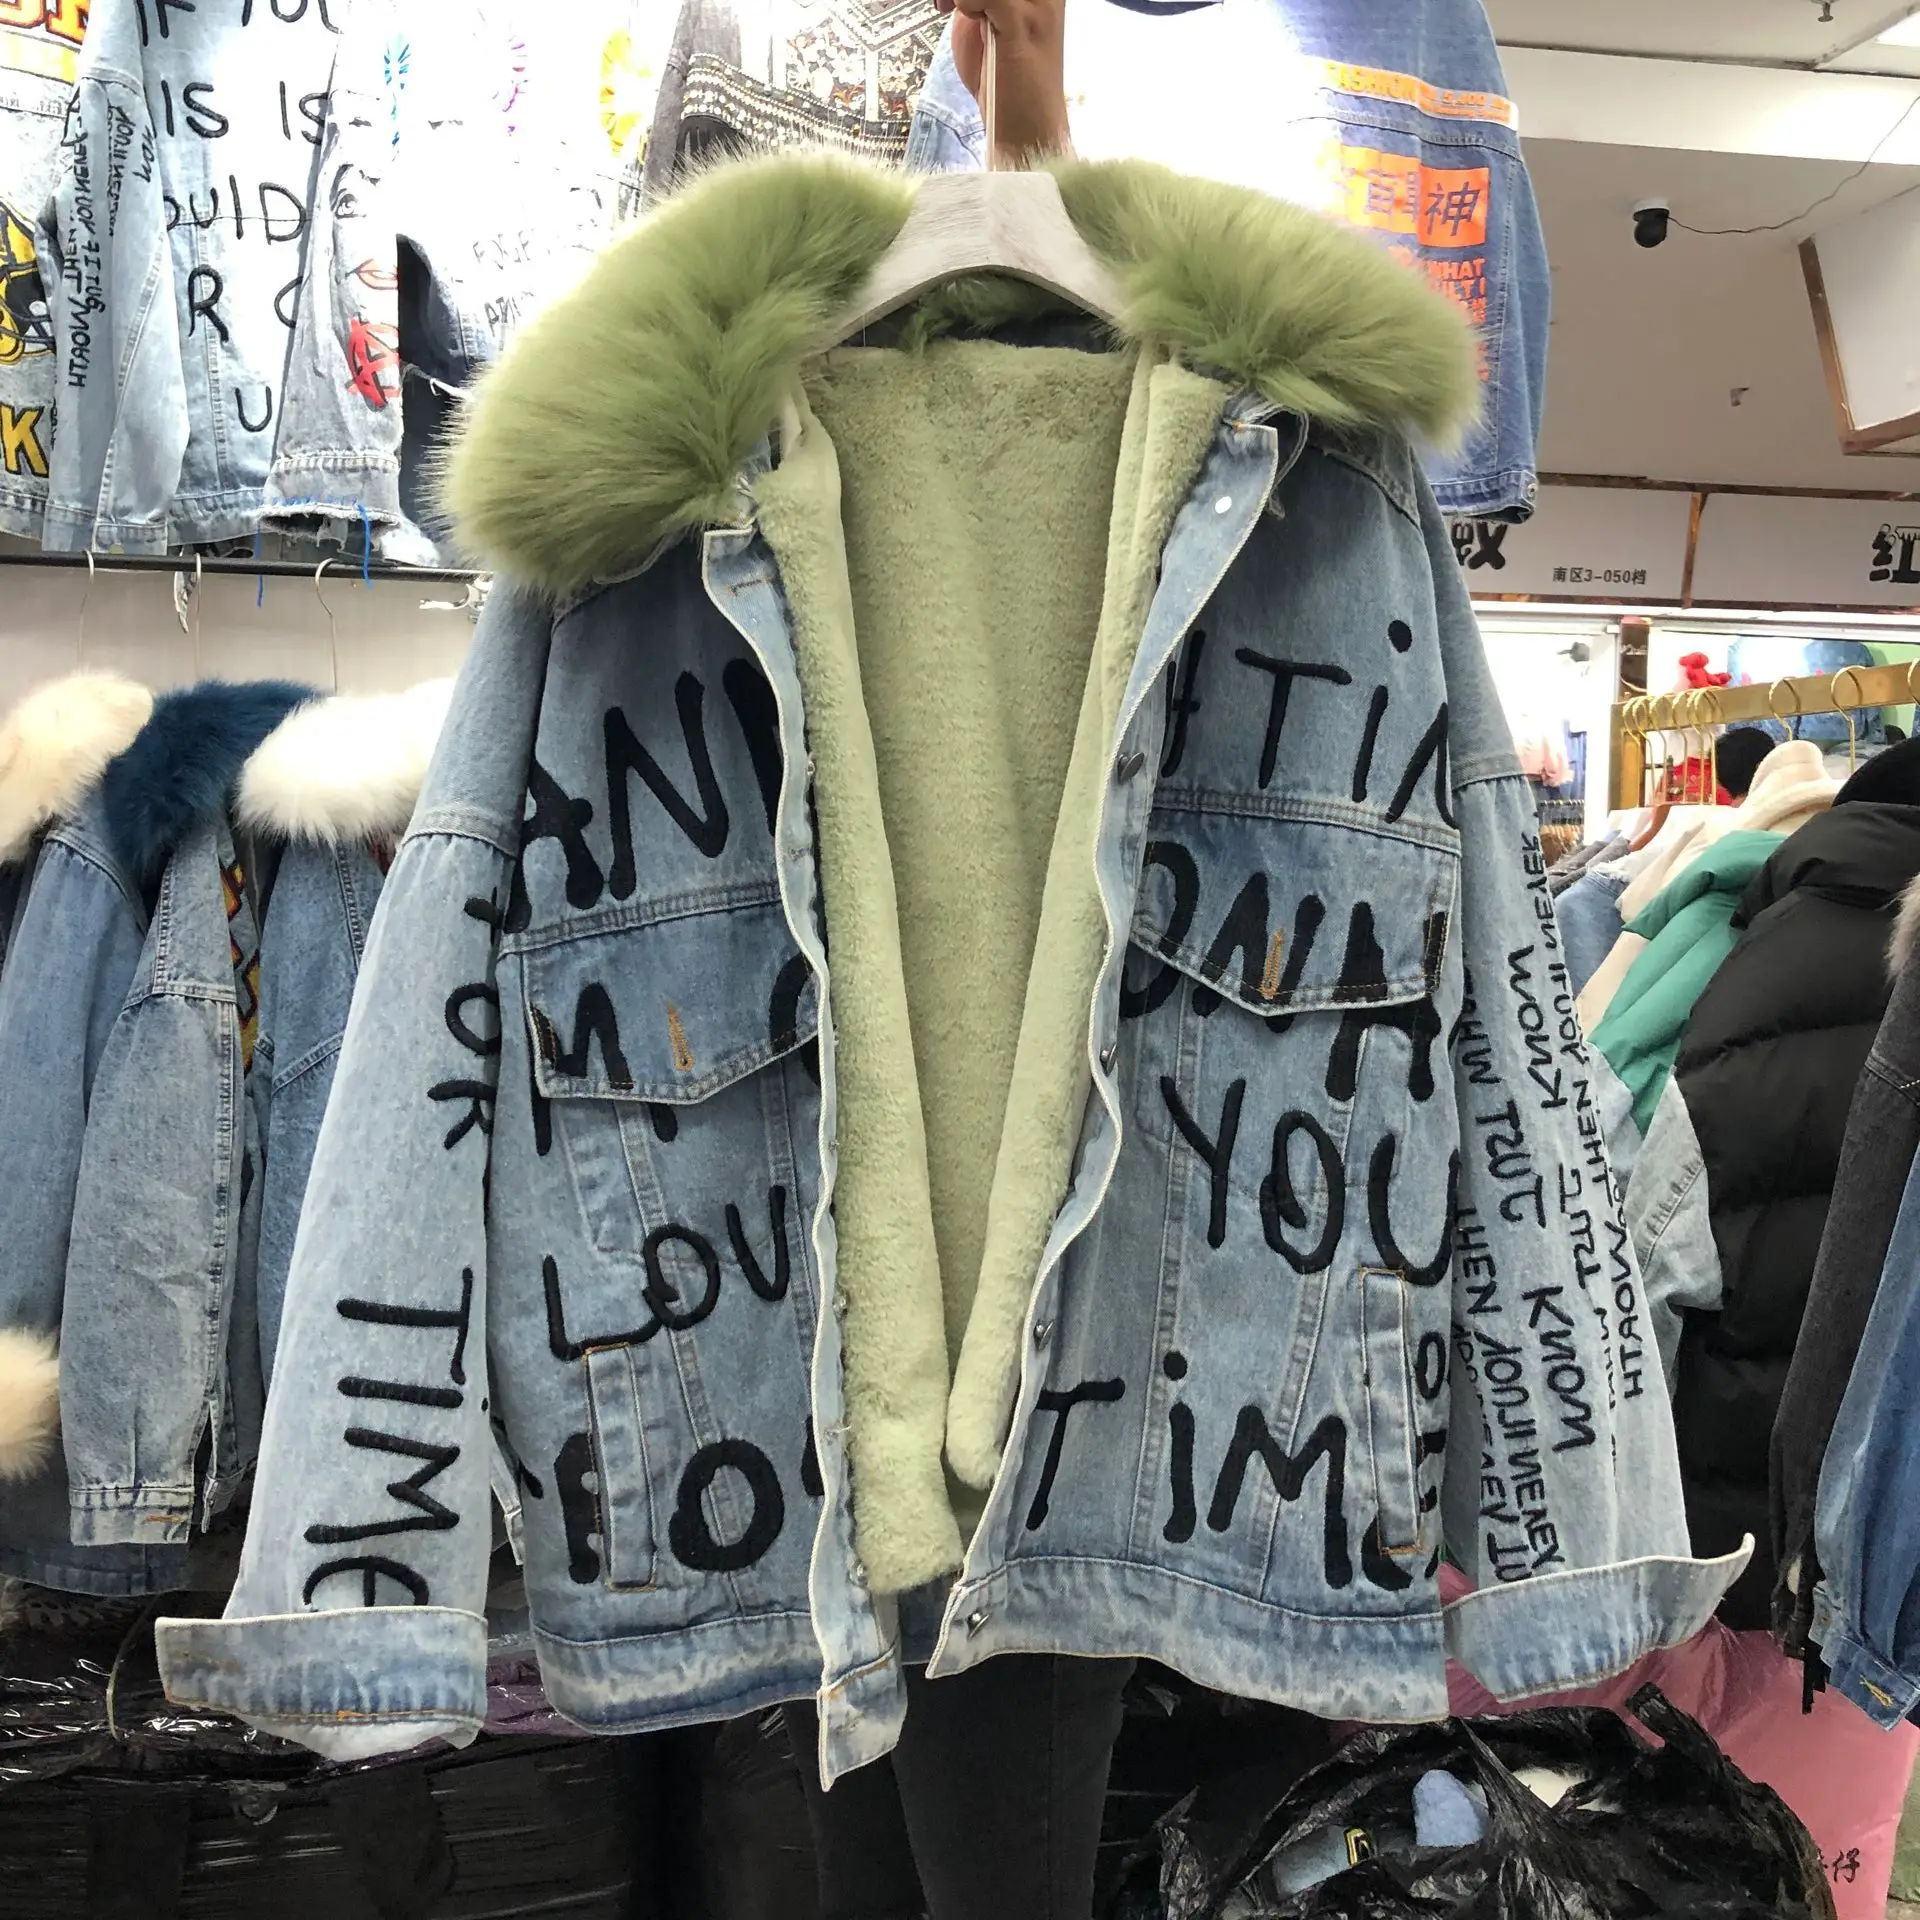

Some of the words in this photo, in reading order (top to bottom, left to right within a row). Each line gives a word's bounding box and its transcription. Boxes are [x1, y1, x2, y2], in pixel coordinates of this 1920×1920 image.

[1552, 566, 1647, 585] 南区3-050档
[1160, 1075, 1460, 1286] YOU
